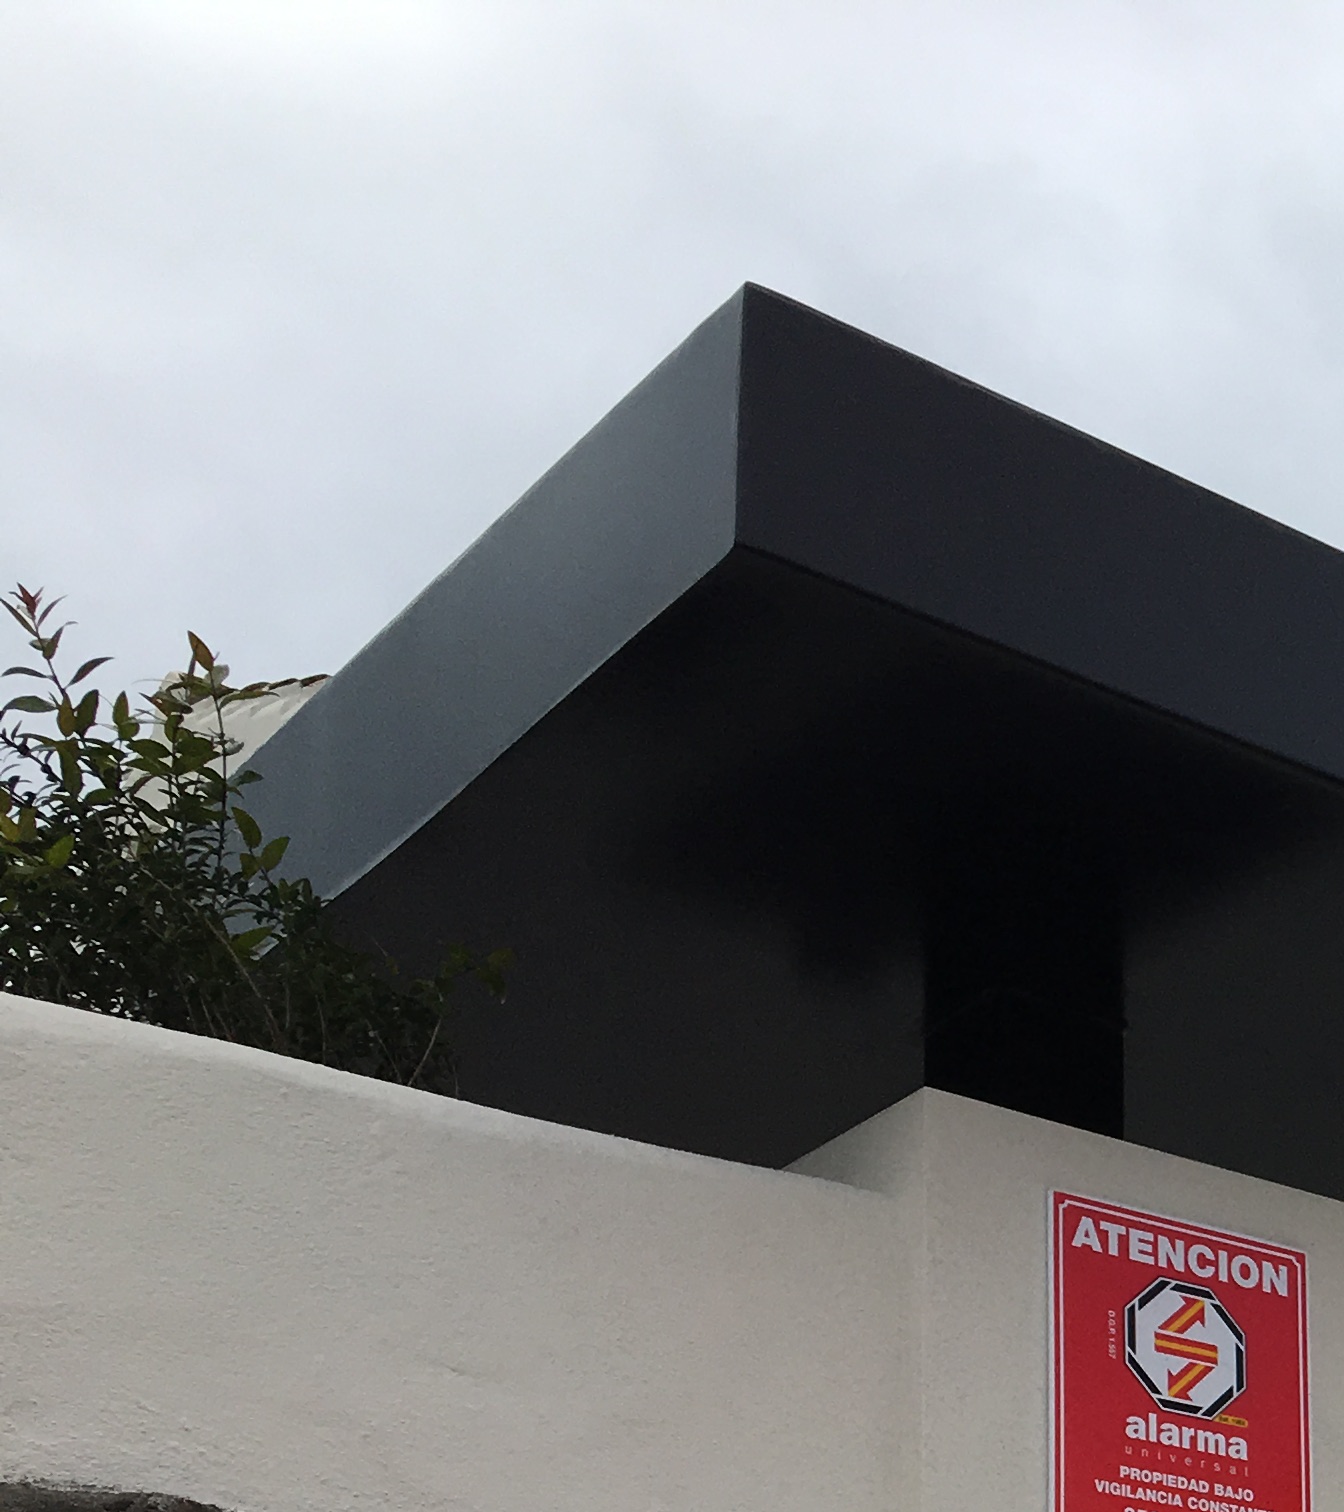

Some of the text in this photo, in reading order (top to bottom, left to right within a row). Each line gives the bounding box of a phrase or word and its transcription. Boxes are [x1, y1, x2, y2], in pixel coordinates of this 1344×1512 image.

[1072, 1216, 1288, 1297] ATENCION
[1125, 1412, 1248, 1461] alarma
[1125, 1445, 1248, 1477] universal
[1094, 1479, 1183, 1508] VIGILANCIA
[1119, 1465, 1254, 1502] PROPIEDAD BAJO
